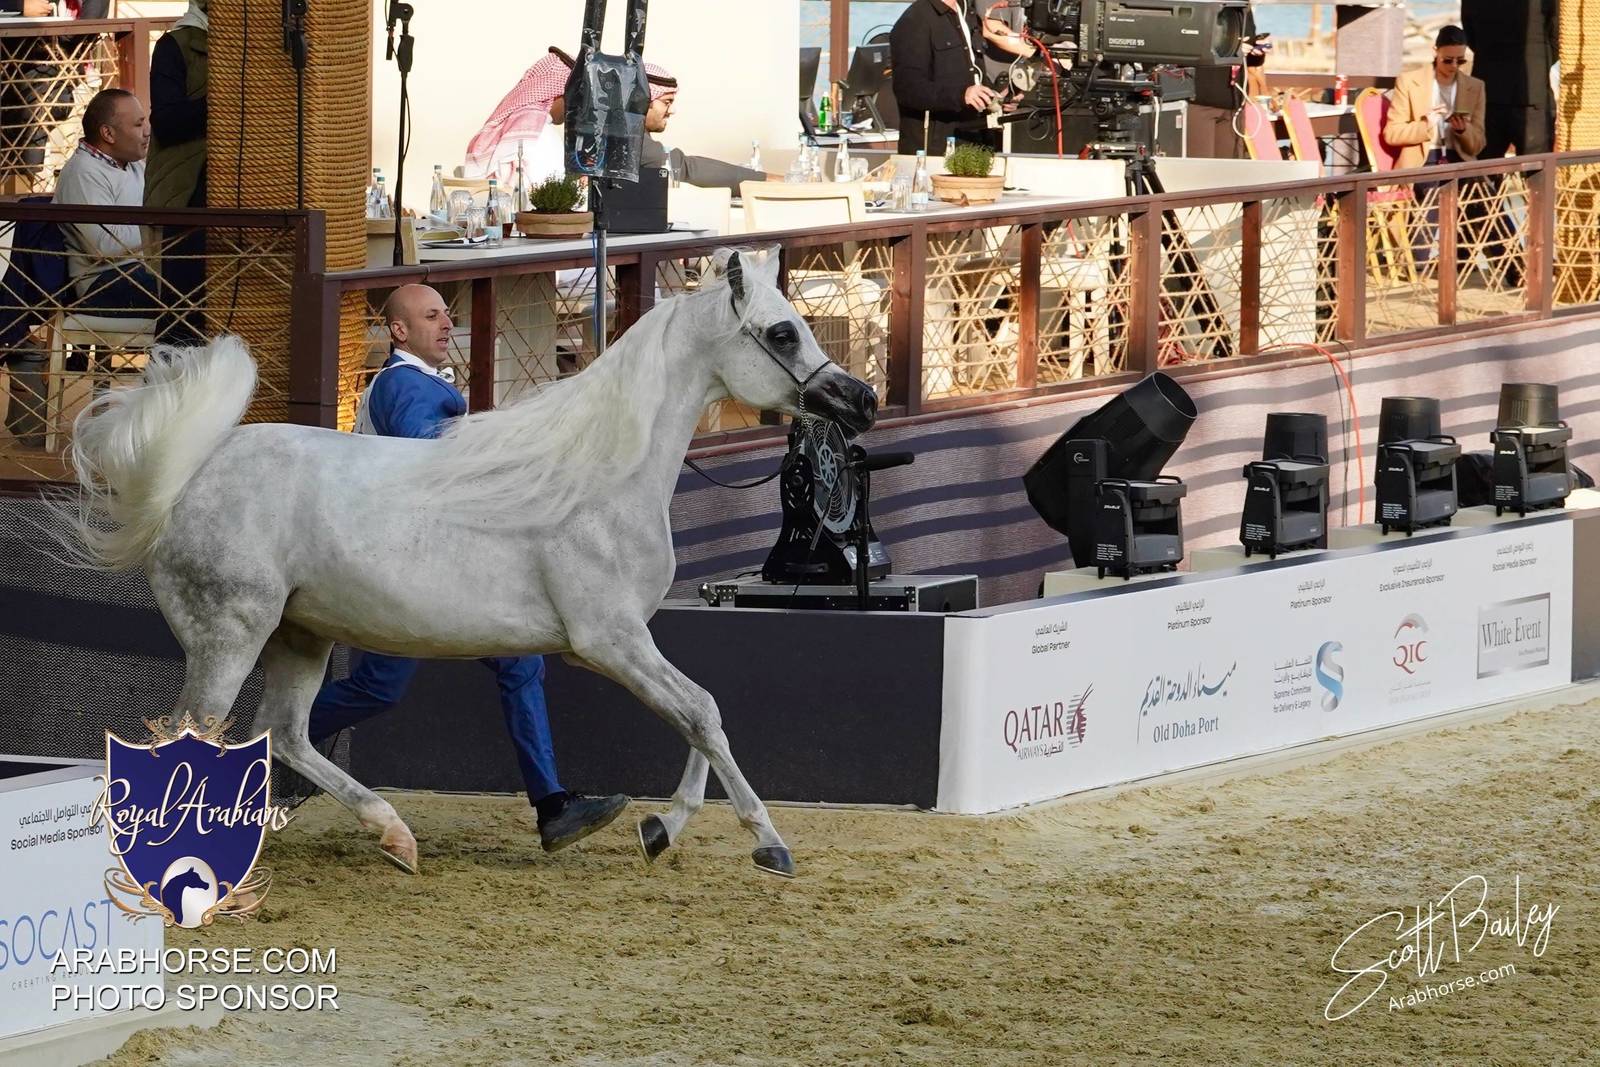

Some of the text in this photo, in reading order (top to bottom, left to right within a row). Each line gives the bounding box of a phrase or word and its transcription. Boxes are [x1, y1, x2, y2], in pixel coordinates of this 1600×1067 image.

[1379, 582, 1401, 592] Exclusive
[1426, 575, 1445, 584] Sponsor
[1290, 596, 1333, 609] Platinum Sponsor
[1168, 616, 1212, 631] Platinum Sponsor
[1481, 616, 1541, 648] White Event
[1031, 640, 1071, 654] Global Partner
[1393, 640, 1429, 675] QIC
[1004, 701, 1064, 753] QATAR
[1153, 716, 1219, 744] Old Doha Port
[1017, 744, 1043, 761] AIRWAYS
[19, 808, 53, 829] الاجتماعي
[53, 803, 79, 823] التواصل
[11, 823, 105, 851] Social Media Sponsor
